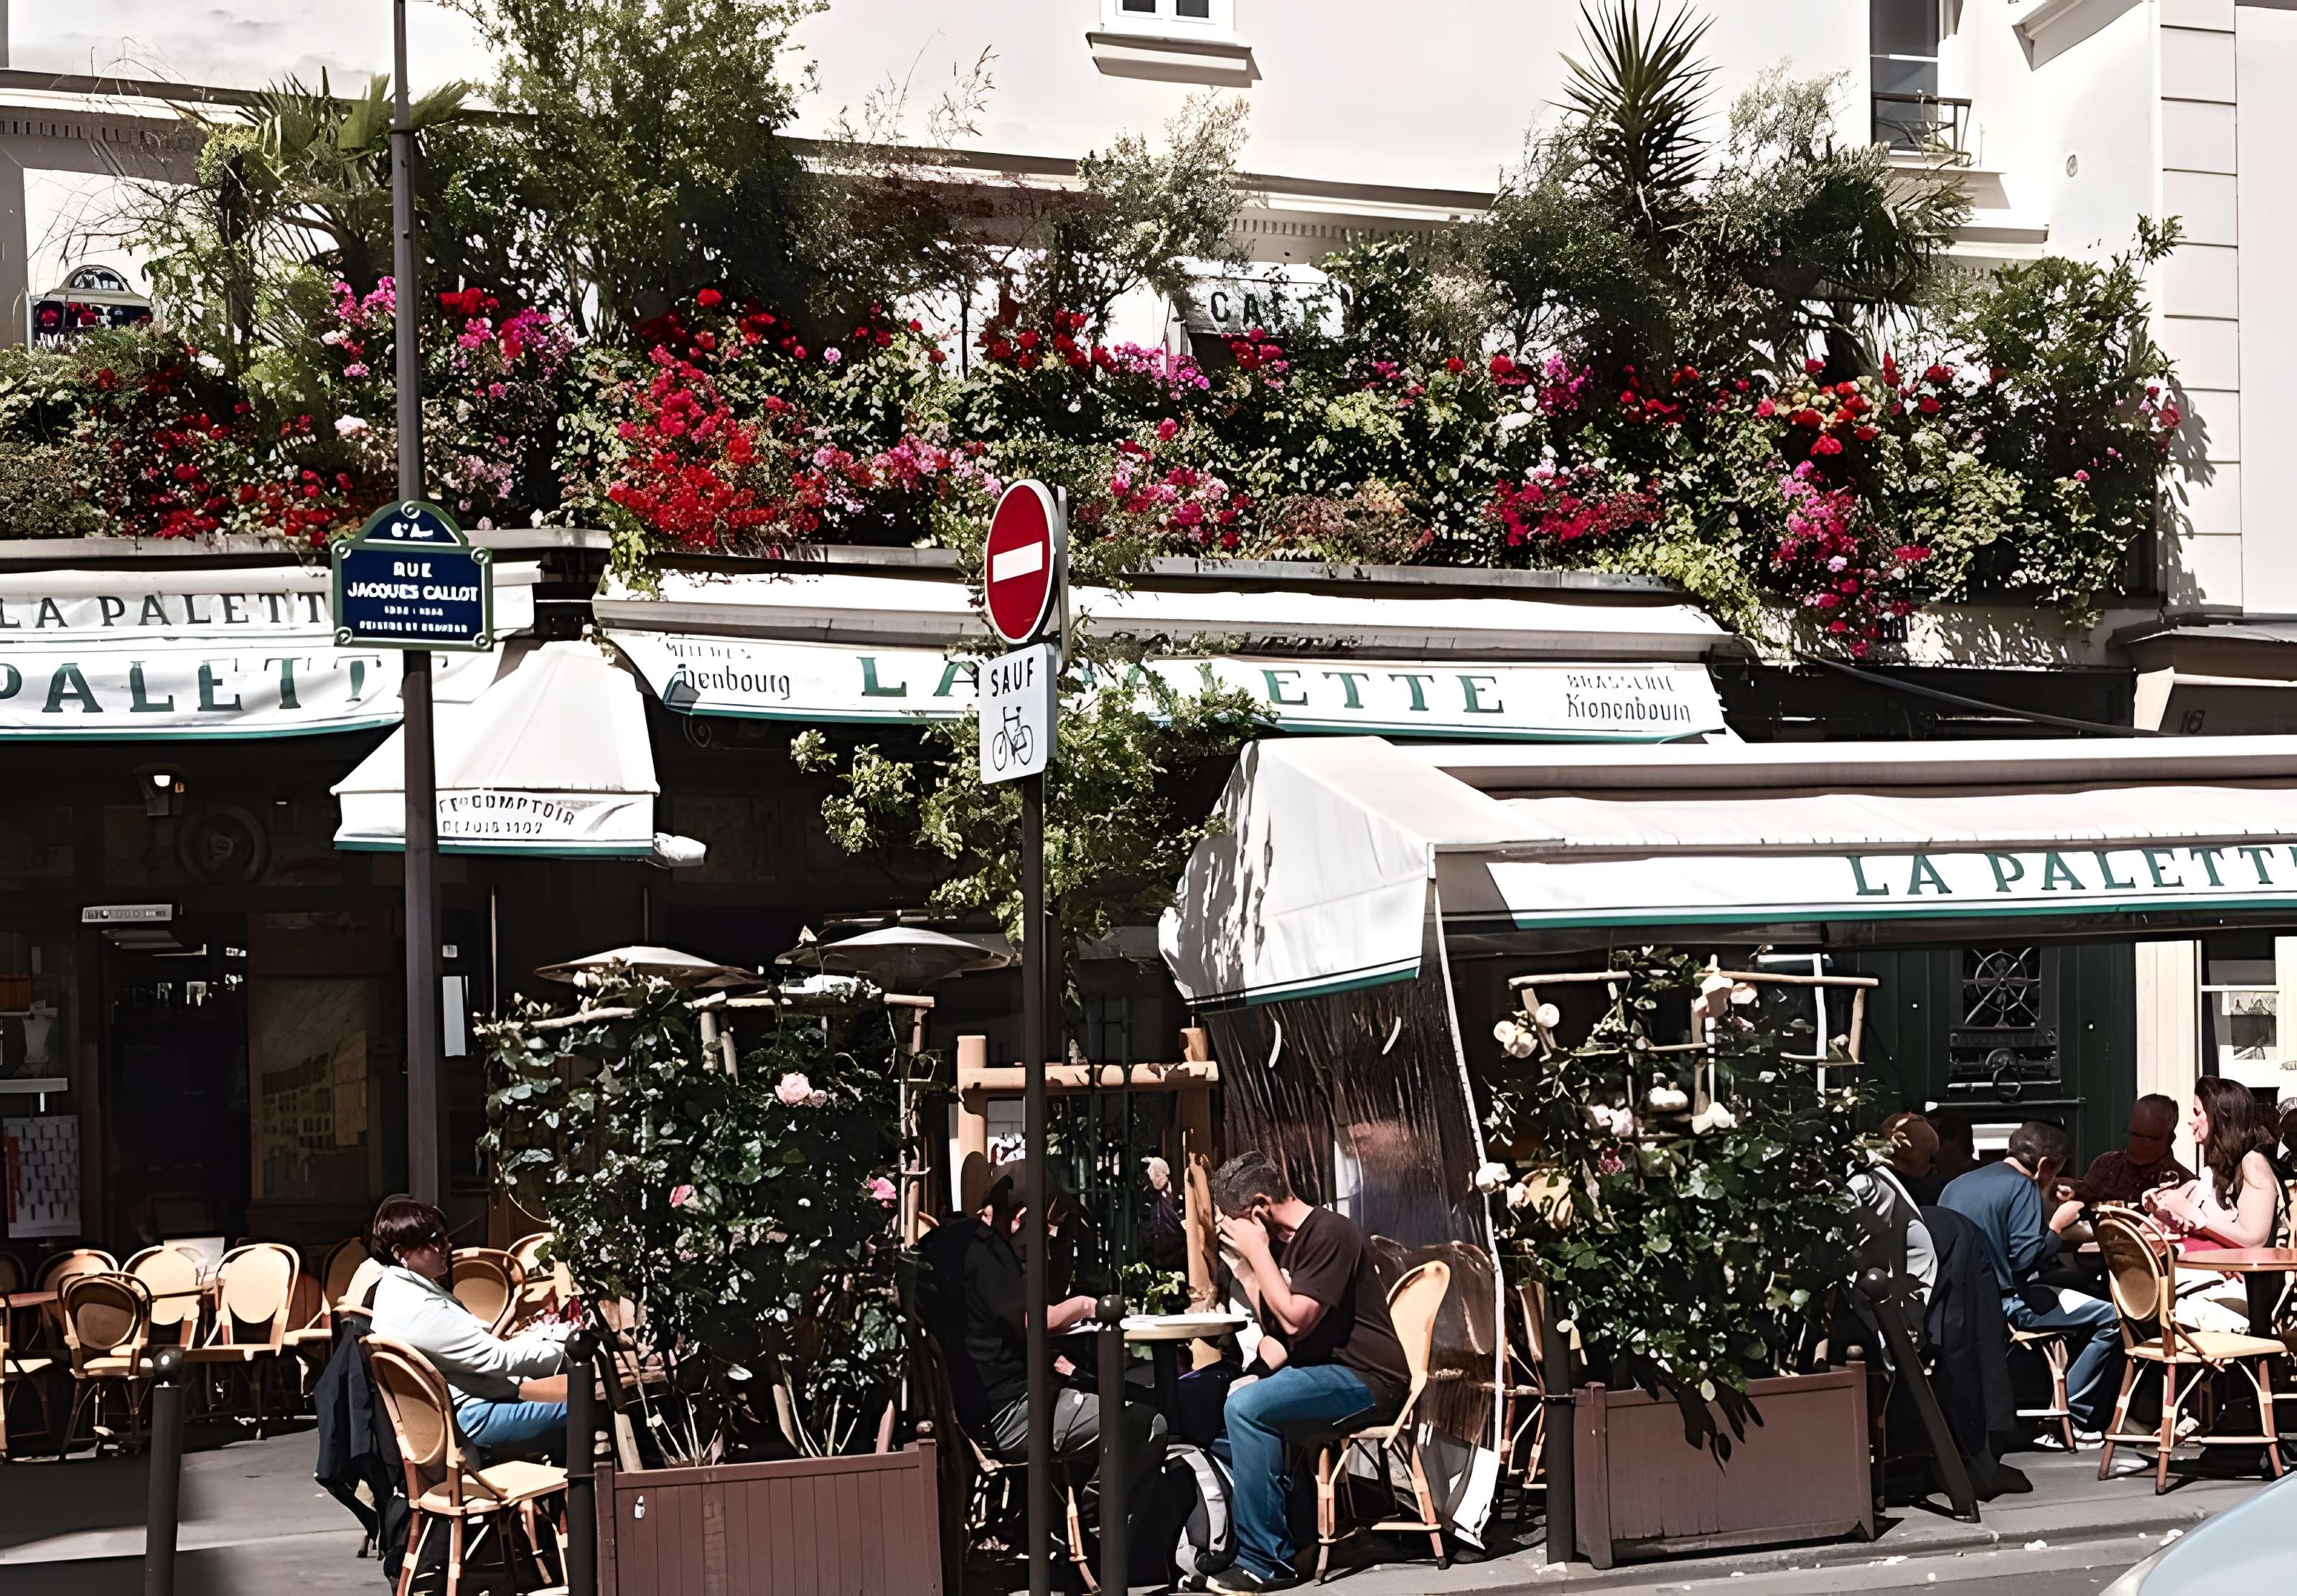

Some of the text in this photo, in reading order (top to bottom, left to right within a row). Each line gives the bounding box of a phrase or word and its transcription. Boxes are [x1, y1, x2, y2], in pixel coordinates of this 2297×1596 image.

[1211, 291, 1315, 332] CA
[393, 562, 433, 578] RUE
[0, 592, 325, 629] LA PALETT
[347, 582, 478, 601] JACQUES CALLOT
[991, 657, 1034, 698] SAUF
[1846, 846, 2297, 896] LA PALETT
